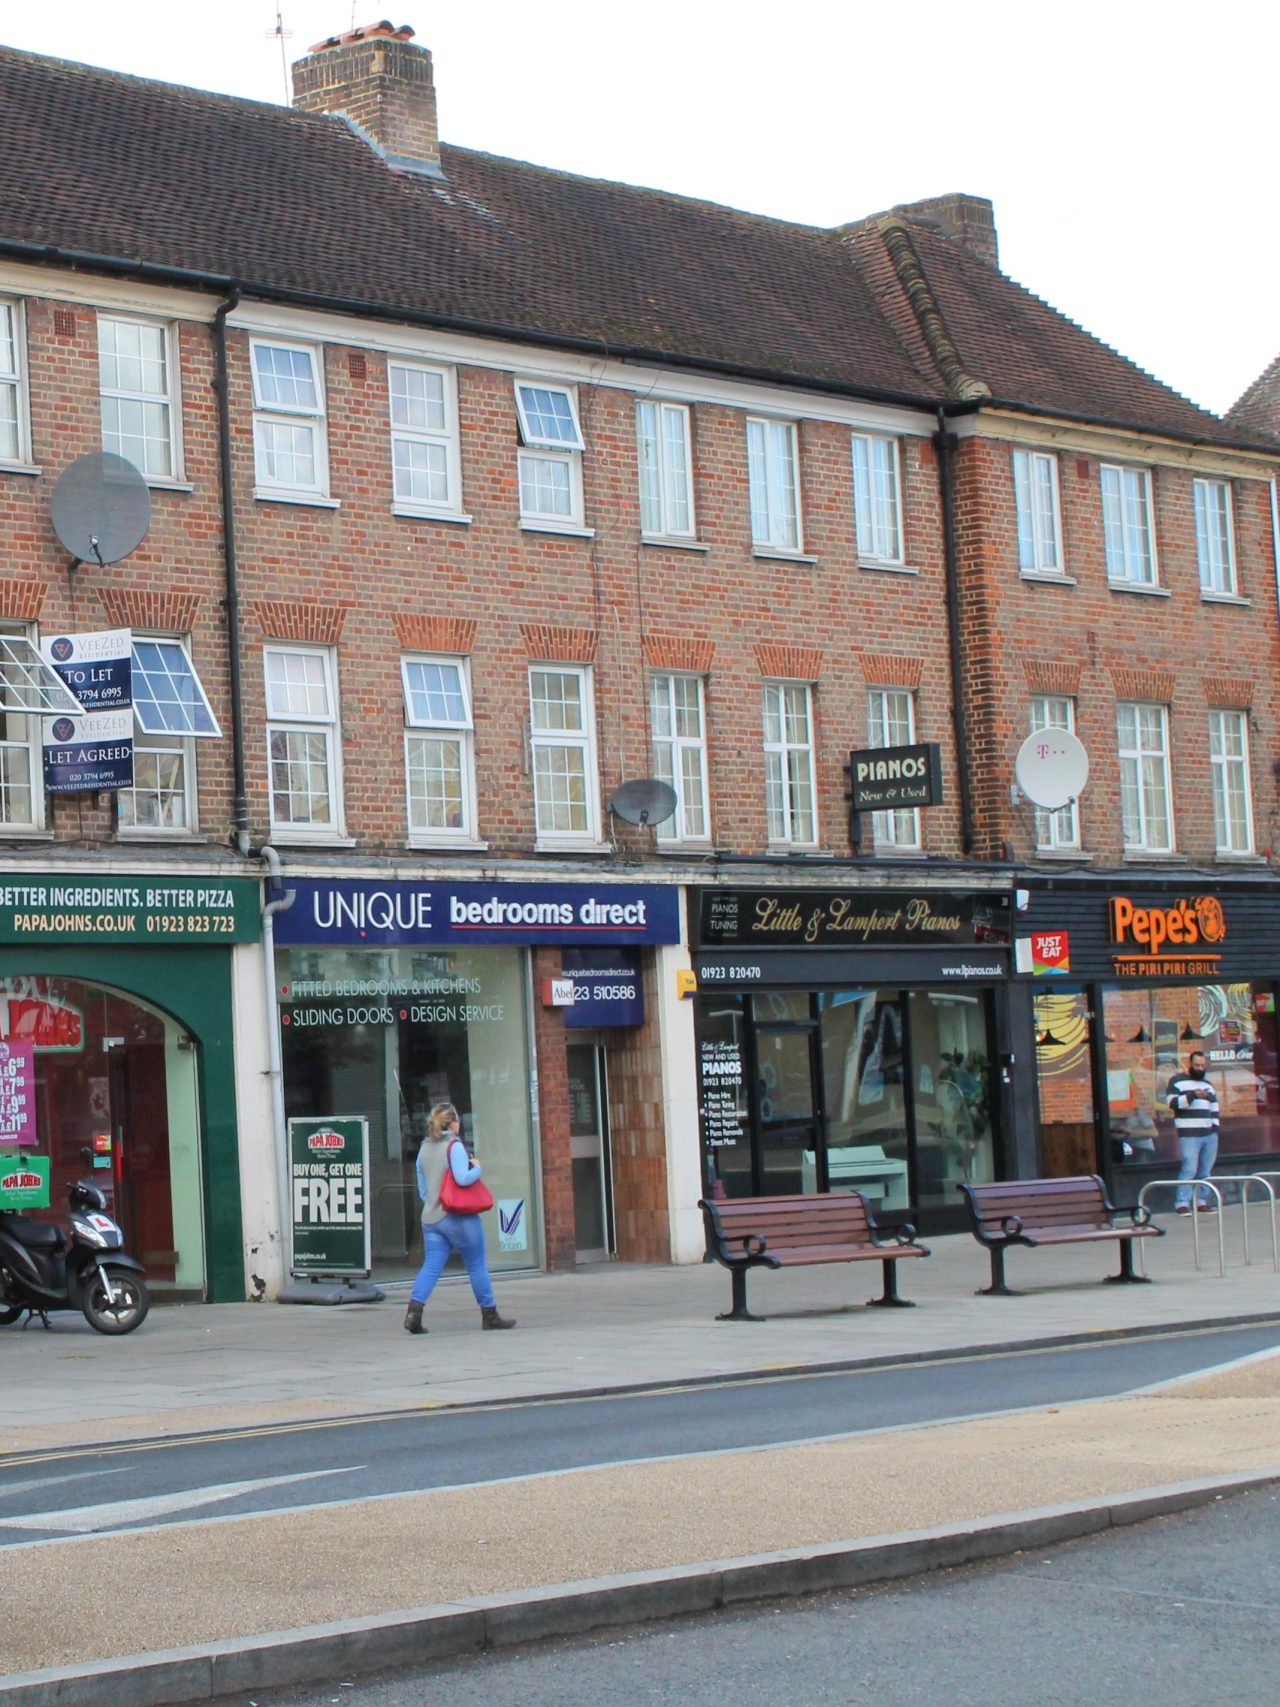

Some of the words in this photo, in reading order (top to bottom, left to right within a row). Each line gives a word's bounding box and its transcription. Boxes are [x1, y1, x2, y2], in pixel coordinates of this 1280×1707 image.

[64, 670, 86, 684] TO
[91, 668, 114, 682] LET
[76, 690, 99, 700] 3794
[101, 687, 122, 698] 6995
[49, 750, 73, 764] LET
[78, 746, 130, 762] AGREED
[83, 772, 98, 780] 3794
[100, 771, 114, 780] 6995
[857, 757, 926, 782] PIANOS
[860, 791, 882, 802] New
[886, 788, 897, 799] &
[901, 786, 926, 798] Used
[50, 887, 144, 908] INGREDIENTS.
[147, 889, 194, 908] BETTER
[197, 890, 234, 908] PIZZA
[313, 890, 432, 934] UNIQUE
[450, 896, 572, 925] bedrooms
[580, 898, 646, 926] direct
[712, 903, 738, 913] PIANOS
[14, 914, 136, 932] PAPAJOHNS.CO.UK
[146, 916, 184, 932] 01923
[187, 916, 210, 932] 823
[212, 916, 235, 932] 723
[710, 921, 738, 930] TUNING
[751, 898, 802, 930] Little
[804, 907, 825, 942] &
[826, 898, 903, 940] Lampert
[905, 898, 960, 930] Pianos
[1111, 896, 1198, 954] Pepe's
[1036, 936, 1062, 950] JUST
[1042, 946, 1062, 958] EAT
[701, 968, 726, 979] 01923
[729, 967, 761, 978] 820470
[1114, 964, 1136, 976] THE
[1138, 963, 1161, 975] PIRI
[1164, 962, 1186, 974] PIRI
[1188, 962, 1220, 974] GRILL
[291, 981, 332, 997] FITTED
[336, 979, 408, 996] BEDROOMS
[412, 980, 422, 995] &
[424, 977, 482, 994] KITCHENS
[554, 986, 573, 998] Abel
[594, 986, 636, 1000] 510586
[293, 1008, 344, 1026] SLIDING
[347, 1007, 394, 1024] DOORS
[410, 1006, 456, 1022] DESIGN
[460, 1004, 504, 1022] SERVICE
[1210, 1050, 1235, 1060] HELLO
[702, 1061, 742, 1075] PIANOS
[703, 1078, 718, 1086] 01923
[721, 1076, 742, 1085] 820470
[310, 1134, 324, 1147] PAPA
[294, 1164, 308, 1176] BUY
[310, 1164, 328, 1178] ONE,
[329, 1164, 344, 1176] GET
[346, 1163, 362, 1176] ONE
[294, 1178, 364, 1222] FREE
[95, 1218, 110, 1228] L
